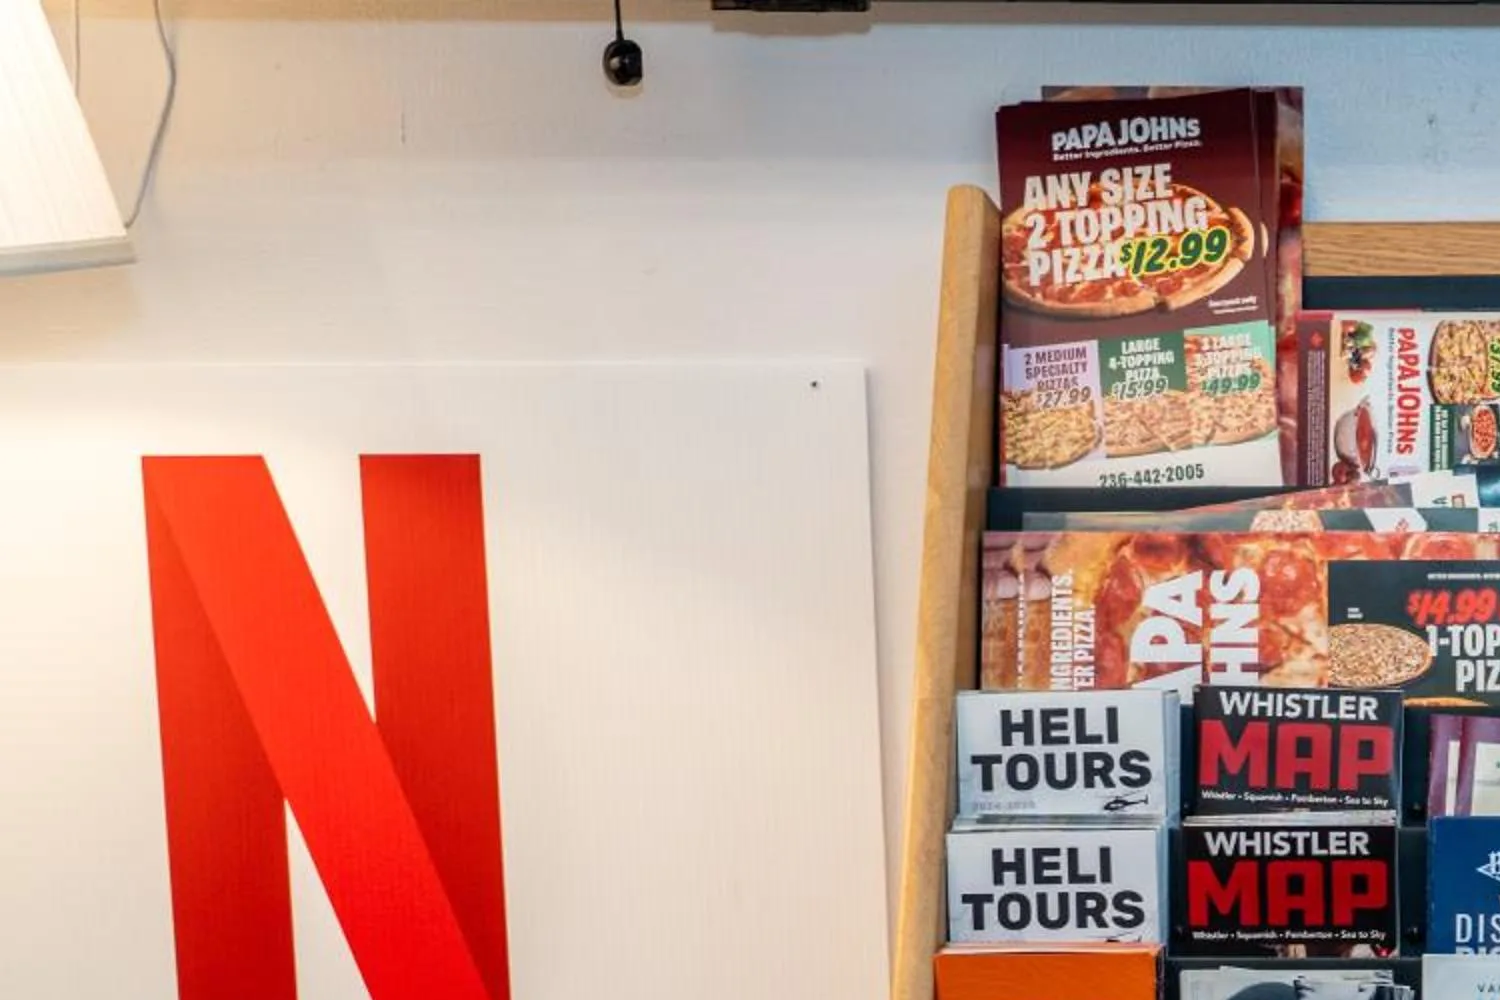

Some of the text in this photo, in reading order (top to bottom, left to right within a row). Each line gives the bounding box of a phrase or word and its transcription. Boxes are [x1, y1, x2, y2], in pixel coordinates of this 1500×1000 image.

[1023, 163, 1172, 210] ANY SIZE
[1026, 197, 1209, 251] 2 TOPPING
[1029, 228, 1229, 286] PIZZA $12.99
[1025, 348, 1087, 365] 2 MEDIUM
[1108, 351, 1175, 370] 4-TOPPING
[1121, 337, 1161, 354] LARGE
[1025, 363, 1088, 380] SPECIALTY
[1099, 463, 1205, 489] 236-442-2005
[1001, 706, 1119, 746] HELI
[970, 750, 1152, 792] TOURS
[1204, 831, 1370, 857] WHISTLER
[1187, 860, 1388, 926] MAP
